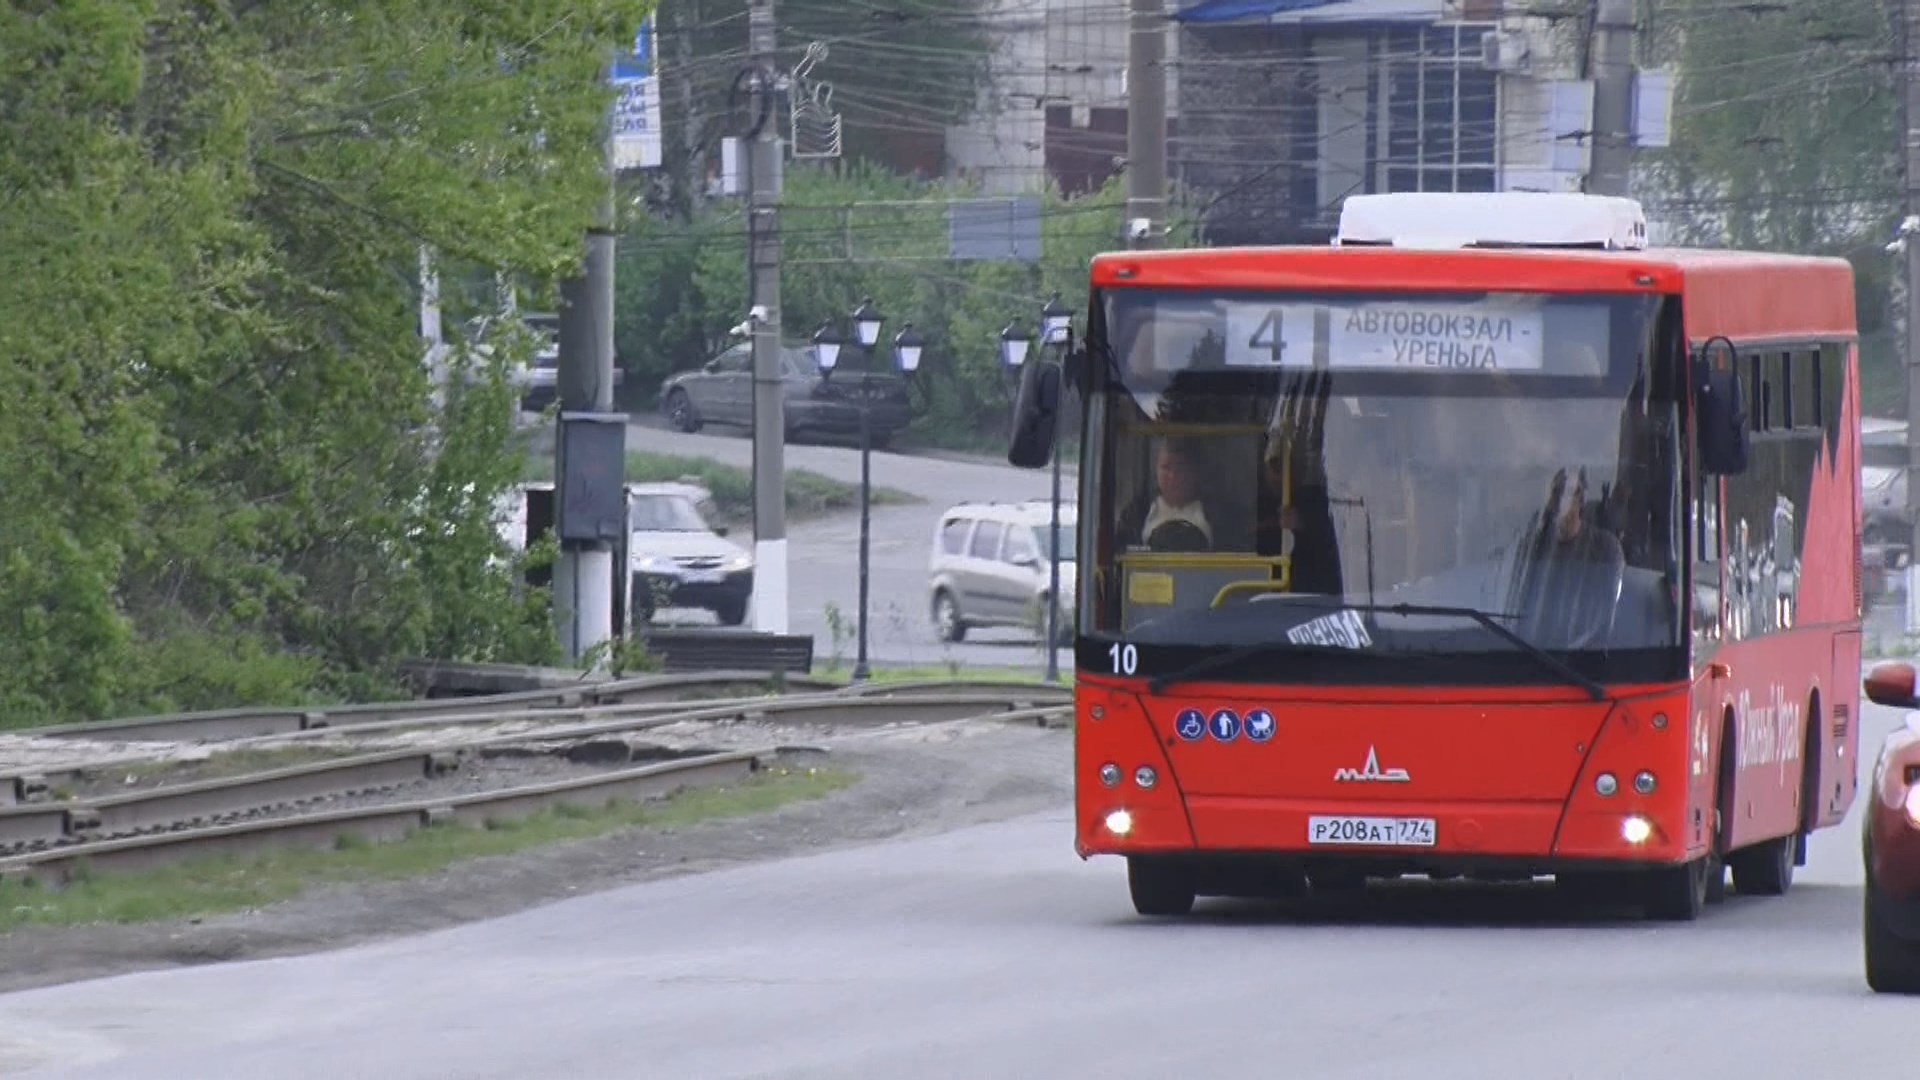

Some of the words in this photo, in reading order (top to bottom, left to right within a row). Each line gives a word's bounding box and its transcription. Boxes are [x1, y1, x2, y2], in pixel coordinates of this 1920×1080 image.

[1250, 308, 1286, 363] 4
[1345, 309, 1512, 342] АВТОВОКЗАЛ
[1392, 338, 1498, 368] УРЕНЬГА
[1109, 642, 1137, 675] 10
[1315, 819, 1394, 841] Р208АТ
[1399, 821, 1430, 837] 774
